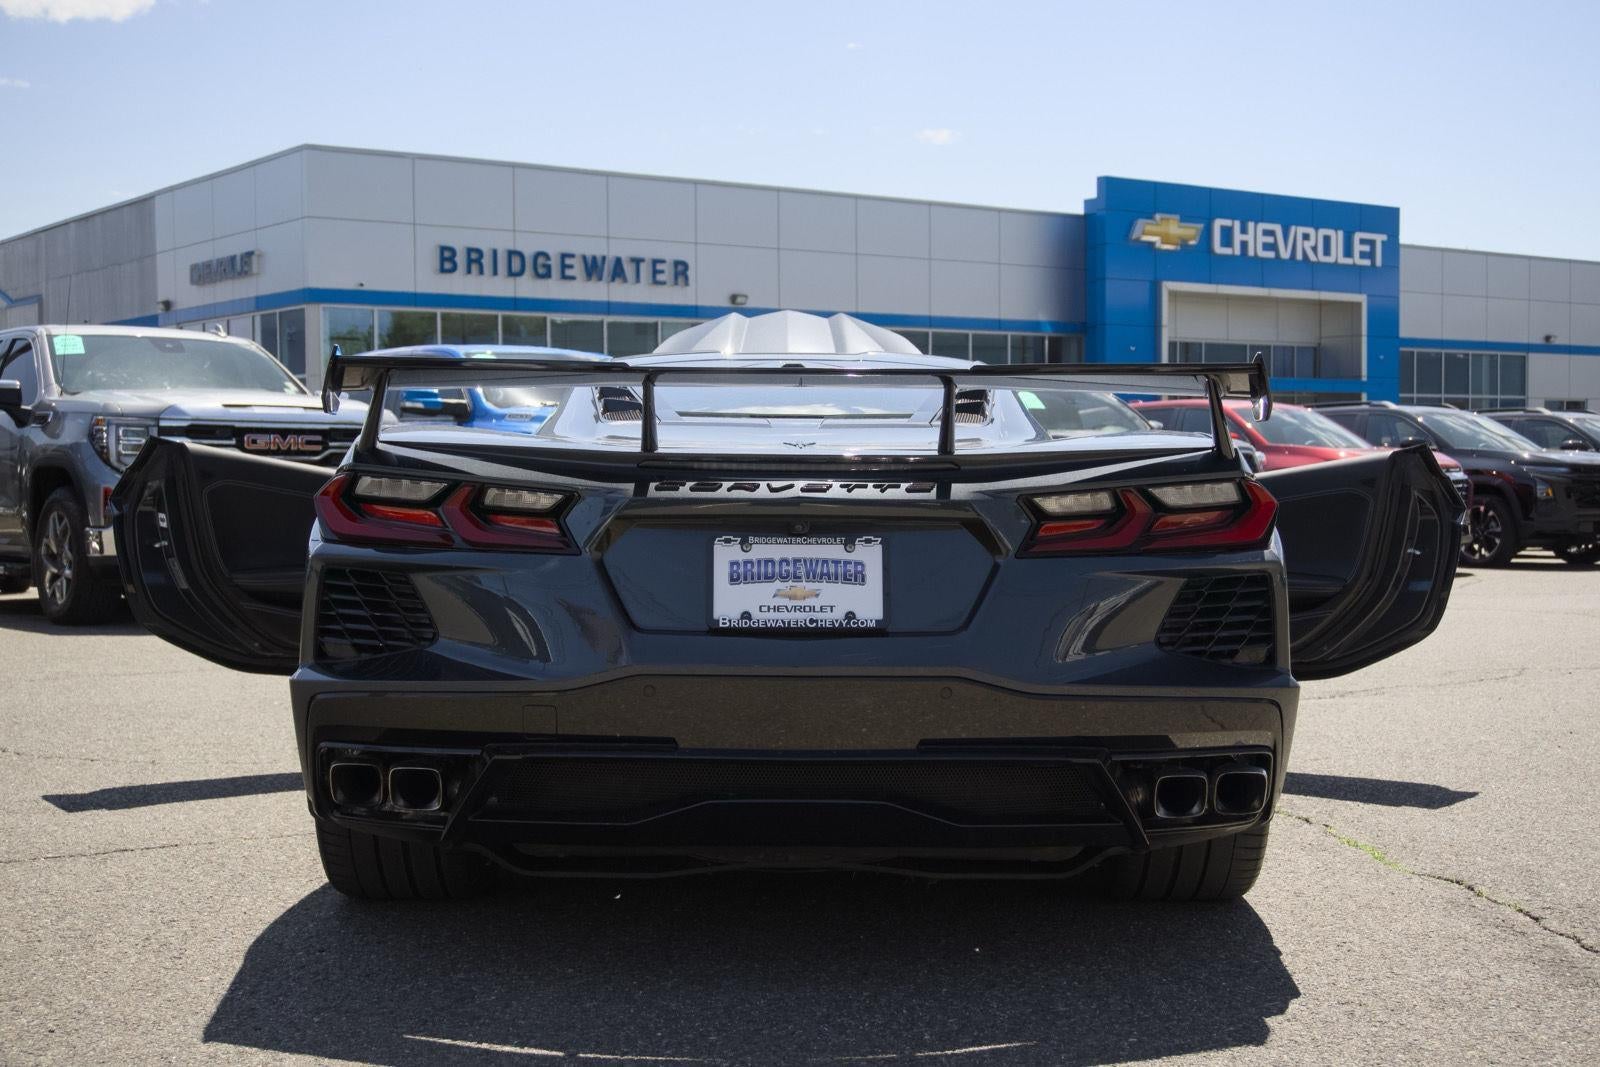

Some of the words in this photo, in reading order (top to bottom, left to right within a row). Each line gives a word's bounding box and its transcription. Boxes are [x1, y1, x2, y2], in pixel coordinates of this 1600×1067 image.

[1213, 218, 1388, 267] CHEVROLET
[438, 244, 690, 286] BRIDGEWATER
[243, 433, 322, 451] GMC
[728, 557, 867, 586] BRIDGEWATER
[758, 604, 836, 614] CHEVROLET
